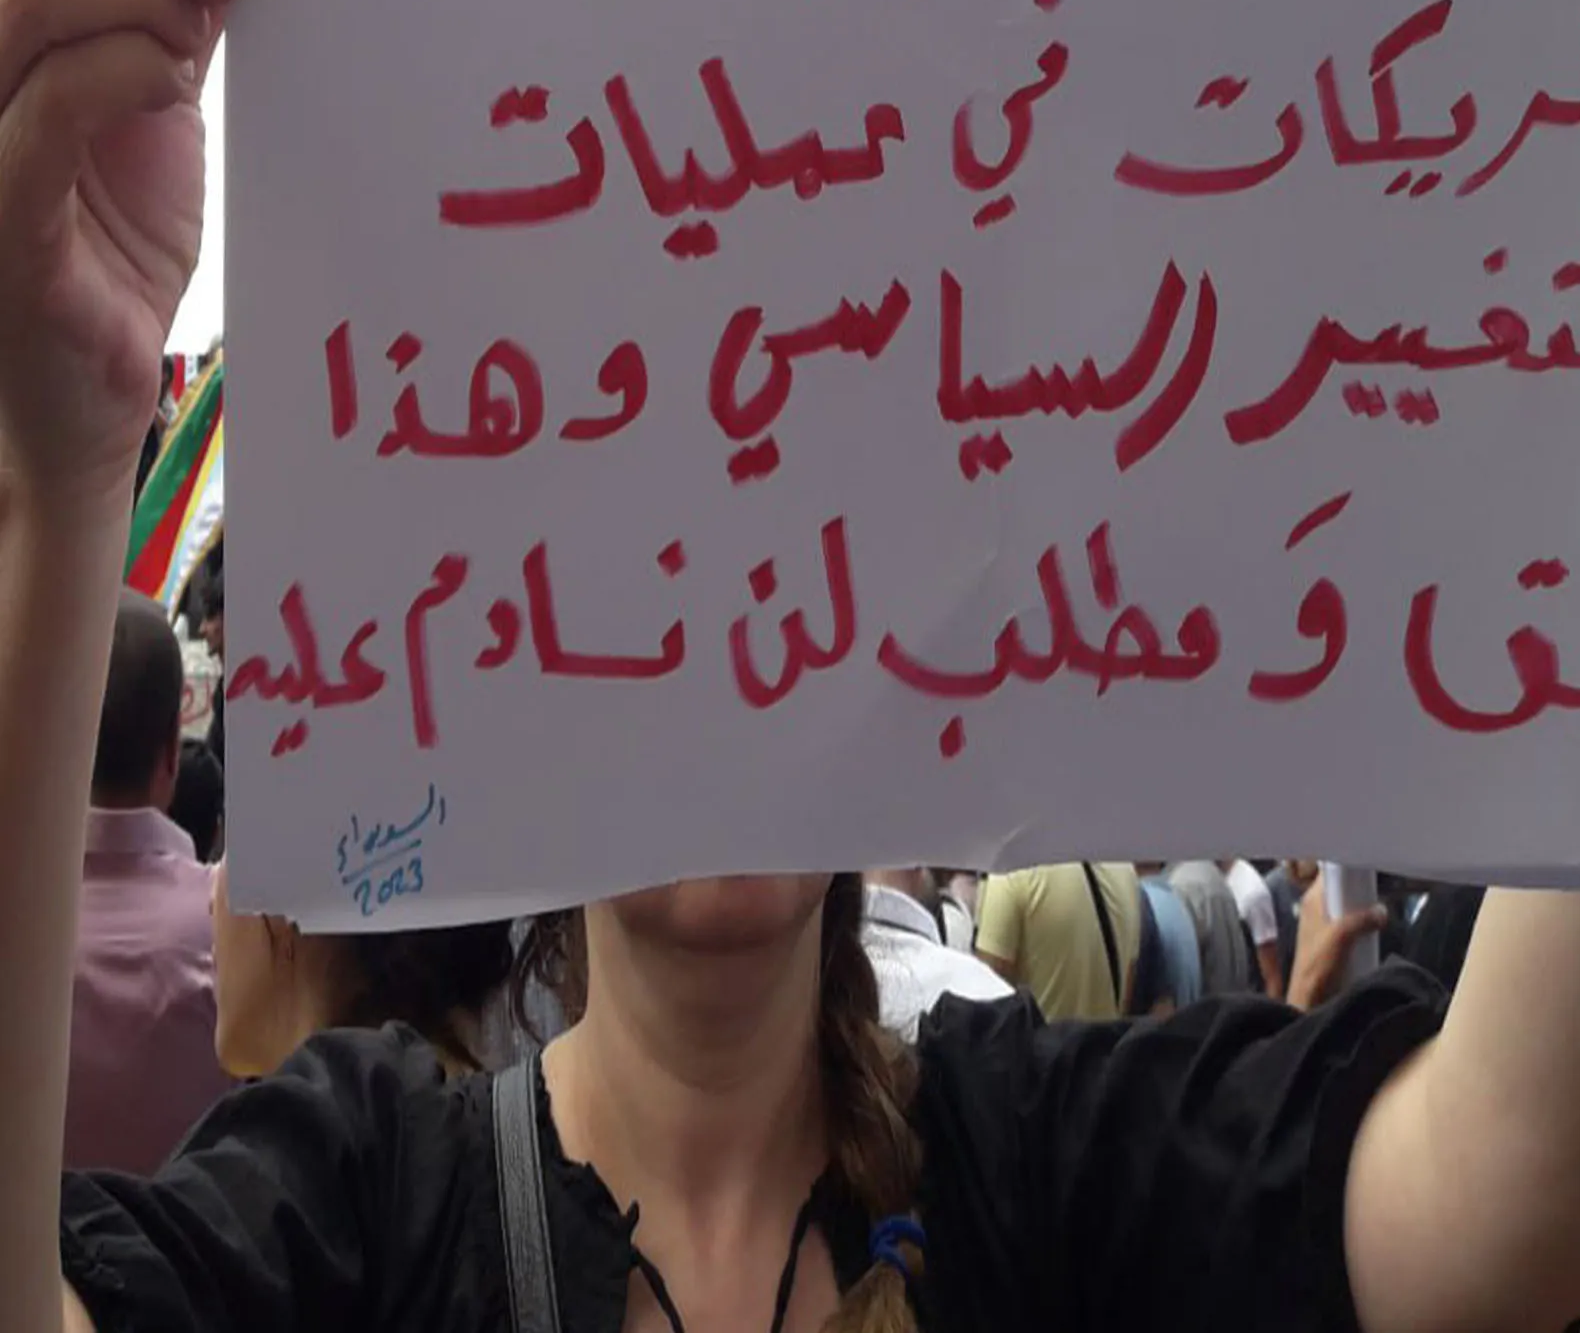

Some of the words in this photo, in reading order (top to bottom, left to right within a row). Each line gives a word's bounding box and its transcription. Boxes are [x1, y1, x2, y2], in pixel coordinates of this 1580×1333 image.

[439, 58, 905, 259] عمليات
[708, 259, 1217, 485] السياسي
[226, 583, 386, 757] عليه
[405, 540, 686, 748] نساوم
[729, 515, 856, 708] لن
[877, 521, 1220, 758] مطلب
